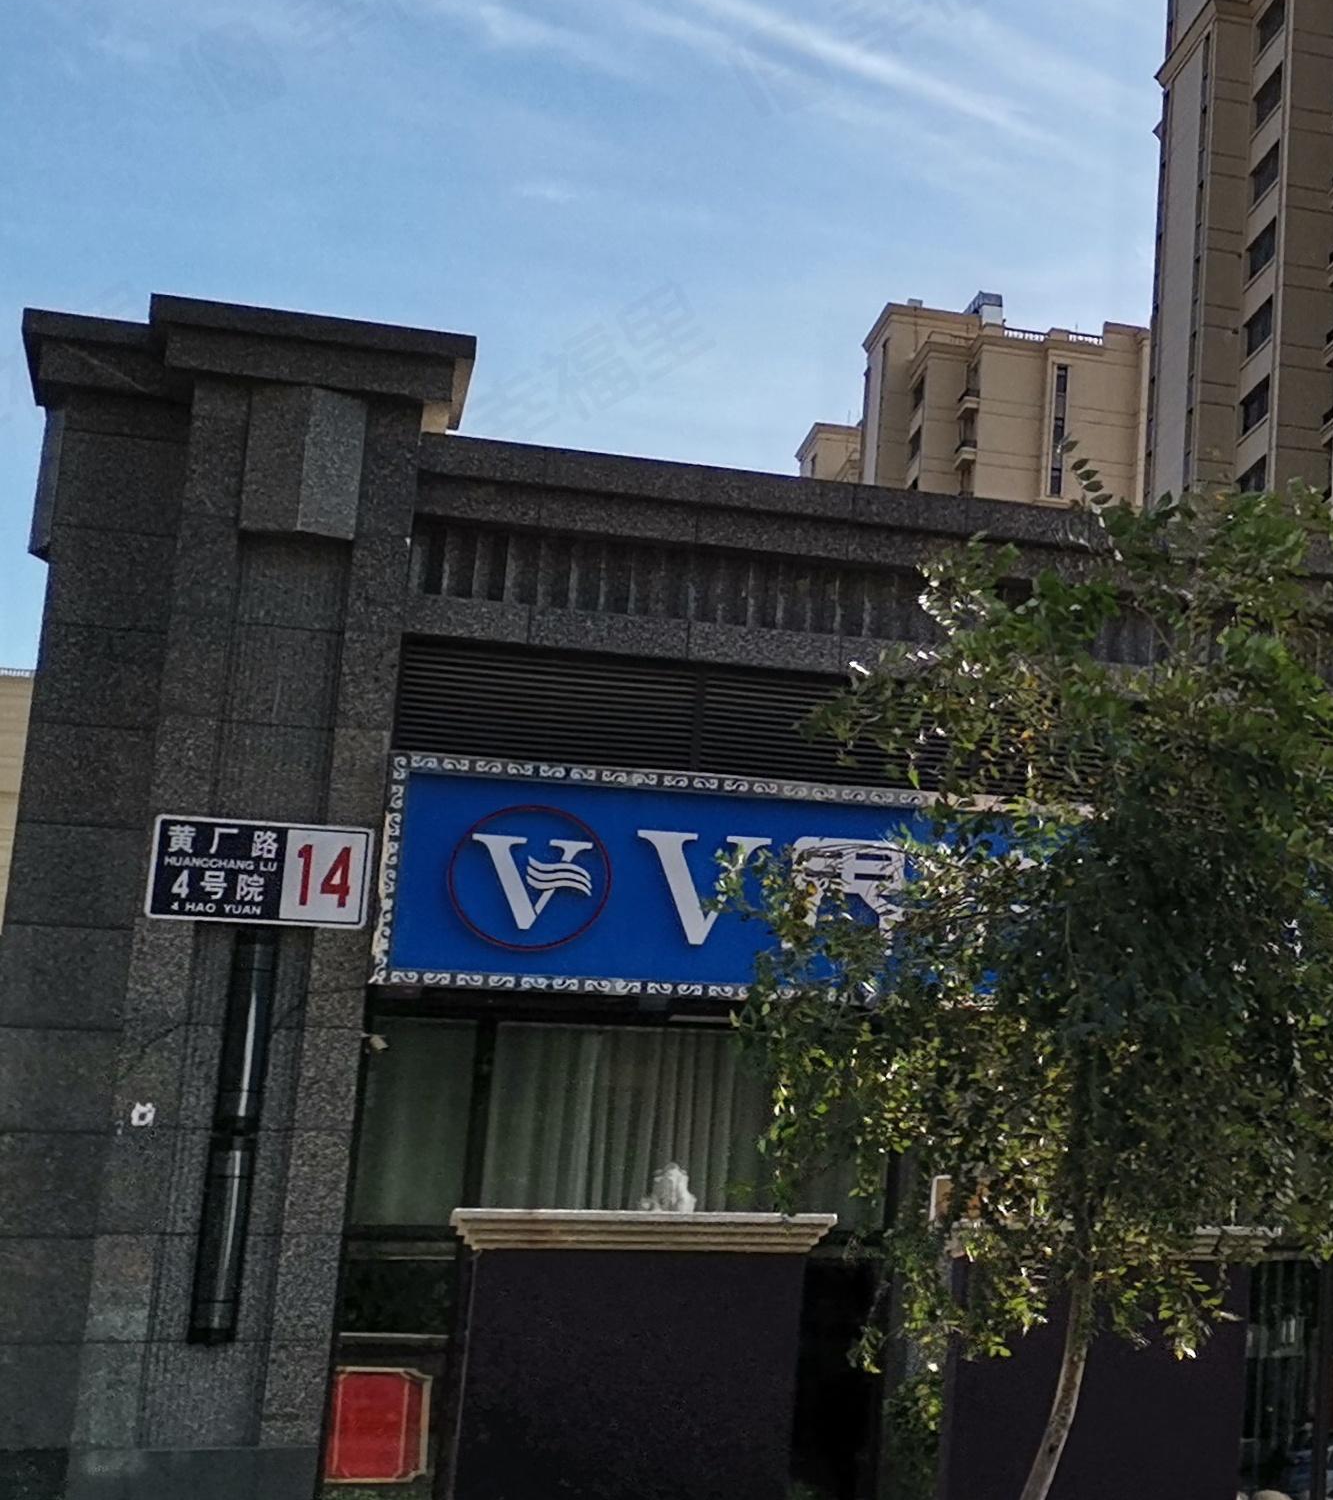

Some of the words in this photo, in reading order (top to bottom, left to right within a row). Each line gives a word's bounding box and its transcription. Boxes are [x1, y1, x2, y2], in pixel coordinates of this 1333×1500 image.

[167, 824, 278, 859] 黄厂路
[260, 861, 277, 872] LU
[297, 843, 353, 908] 14
[171, 869, 264, 902] 4号院
[185, 902, 216, 913] HAO
[223, 903, 261, 915] YUAN
